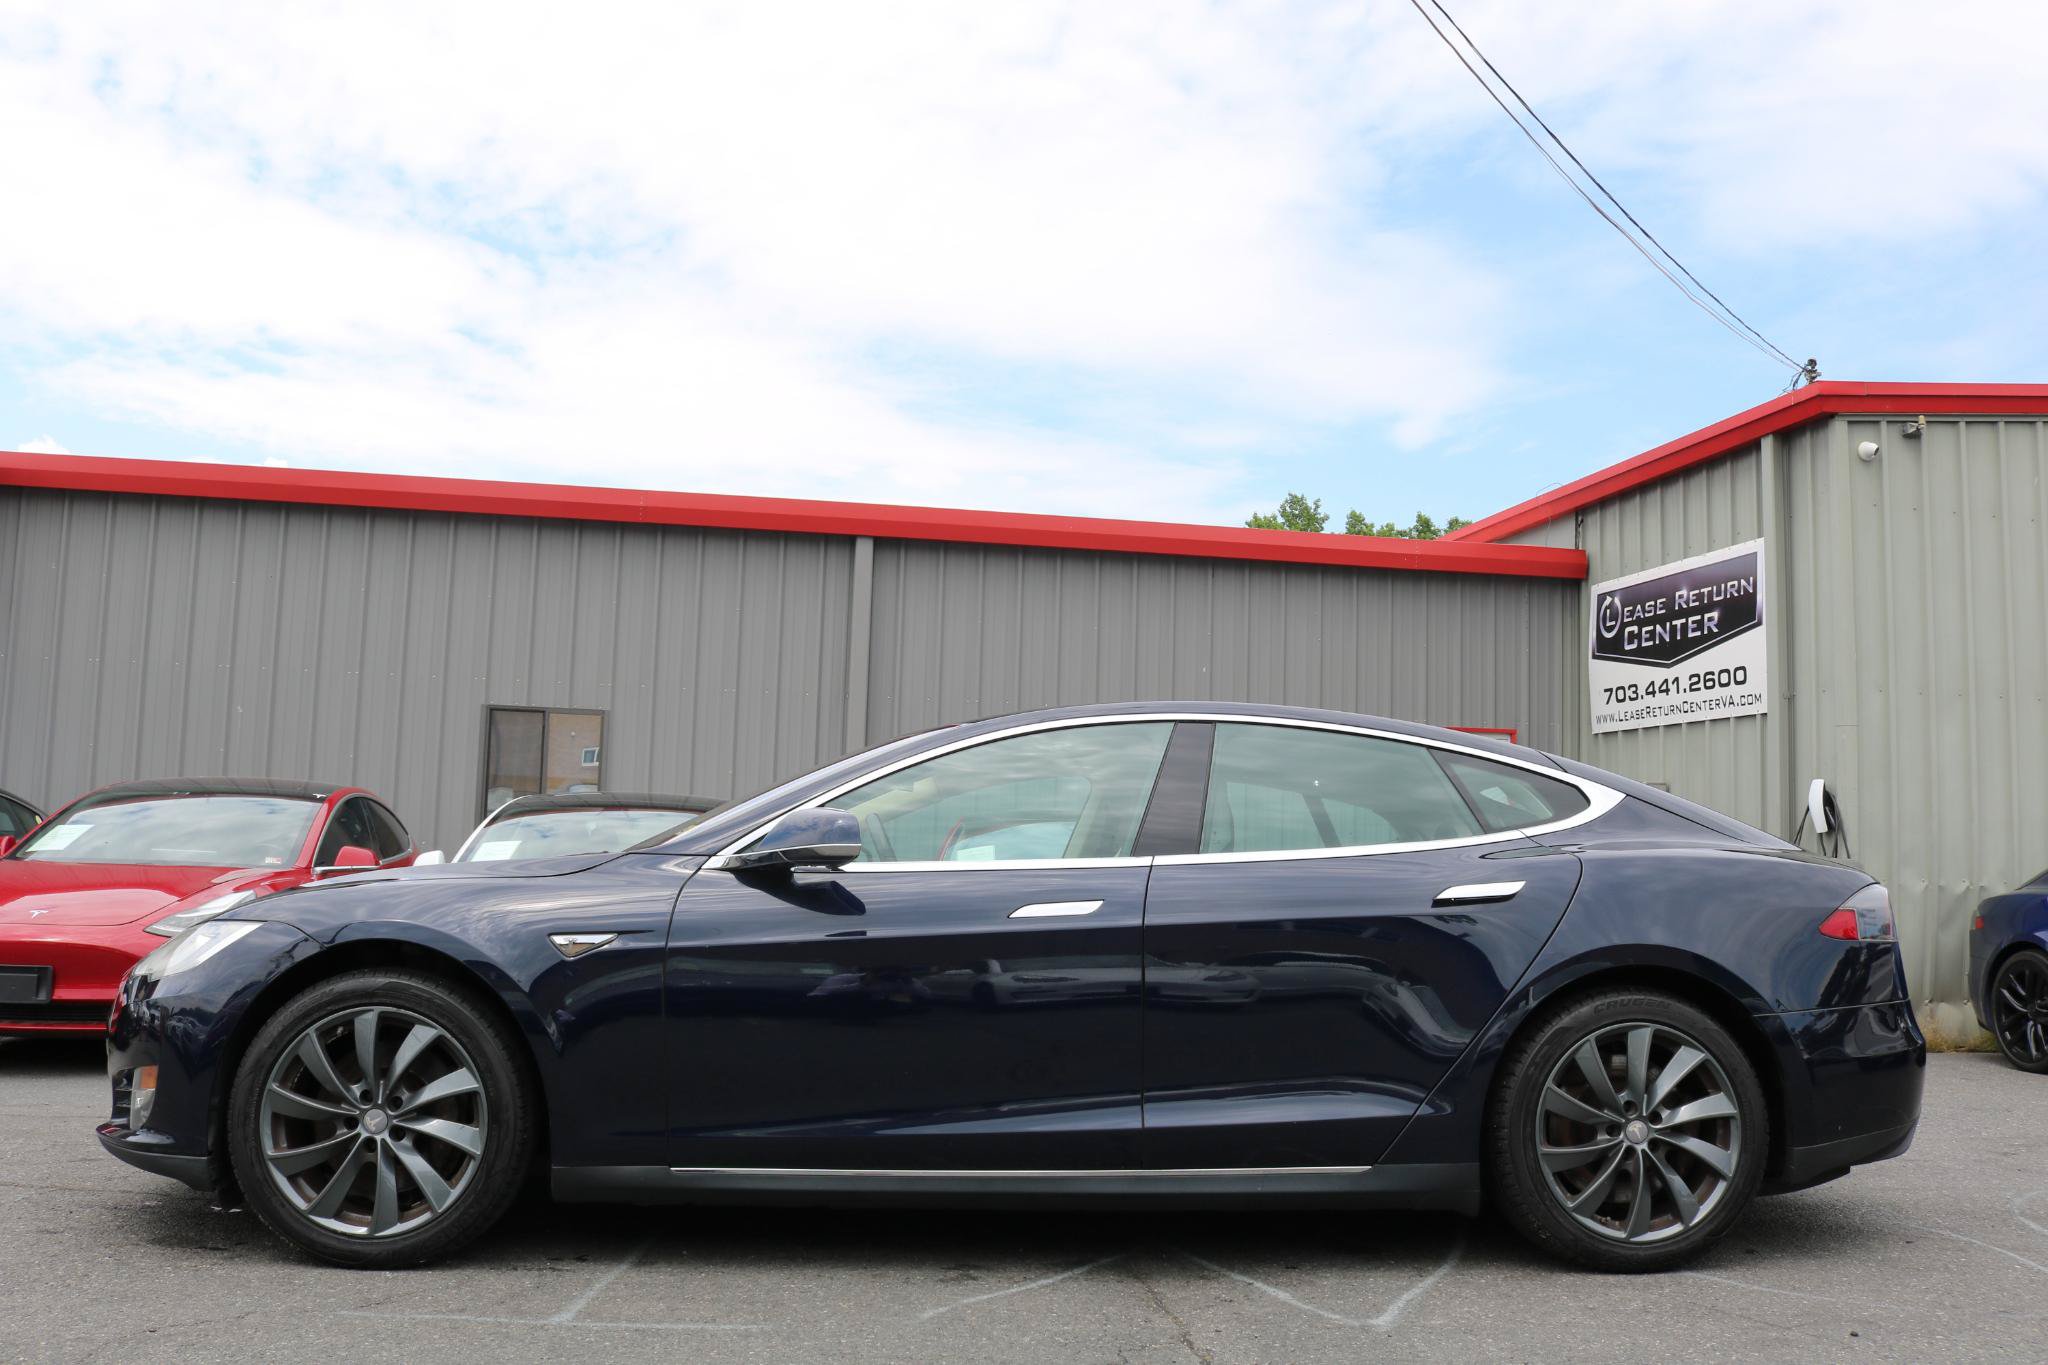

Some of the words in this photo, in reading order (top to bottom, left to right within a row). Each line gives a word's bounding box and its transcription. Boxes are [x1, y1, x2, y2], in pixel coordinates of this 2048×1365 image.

[1604, 597, 1667, 627] LEASE
[1674, 577, 1754, 611] RETURN
[1623, 611, 1719, 651] CENTER
[1603, 665, 1748, 706] 703.441.2600
[1595, 693, 1762, 725] WWW.LEASERETURNCENTERVA.COM
